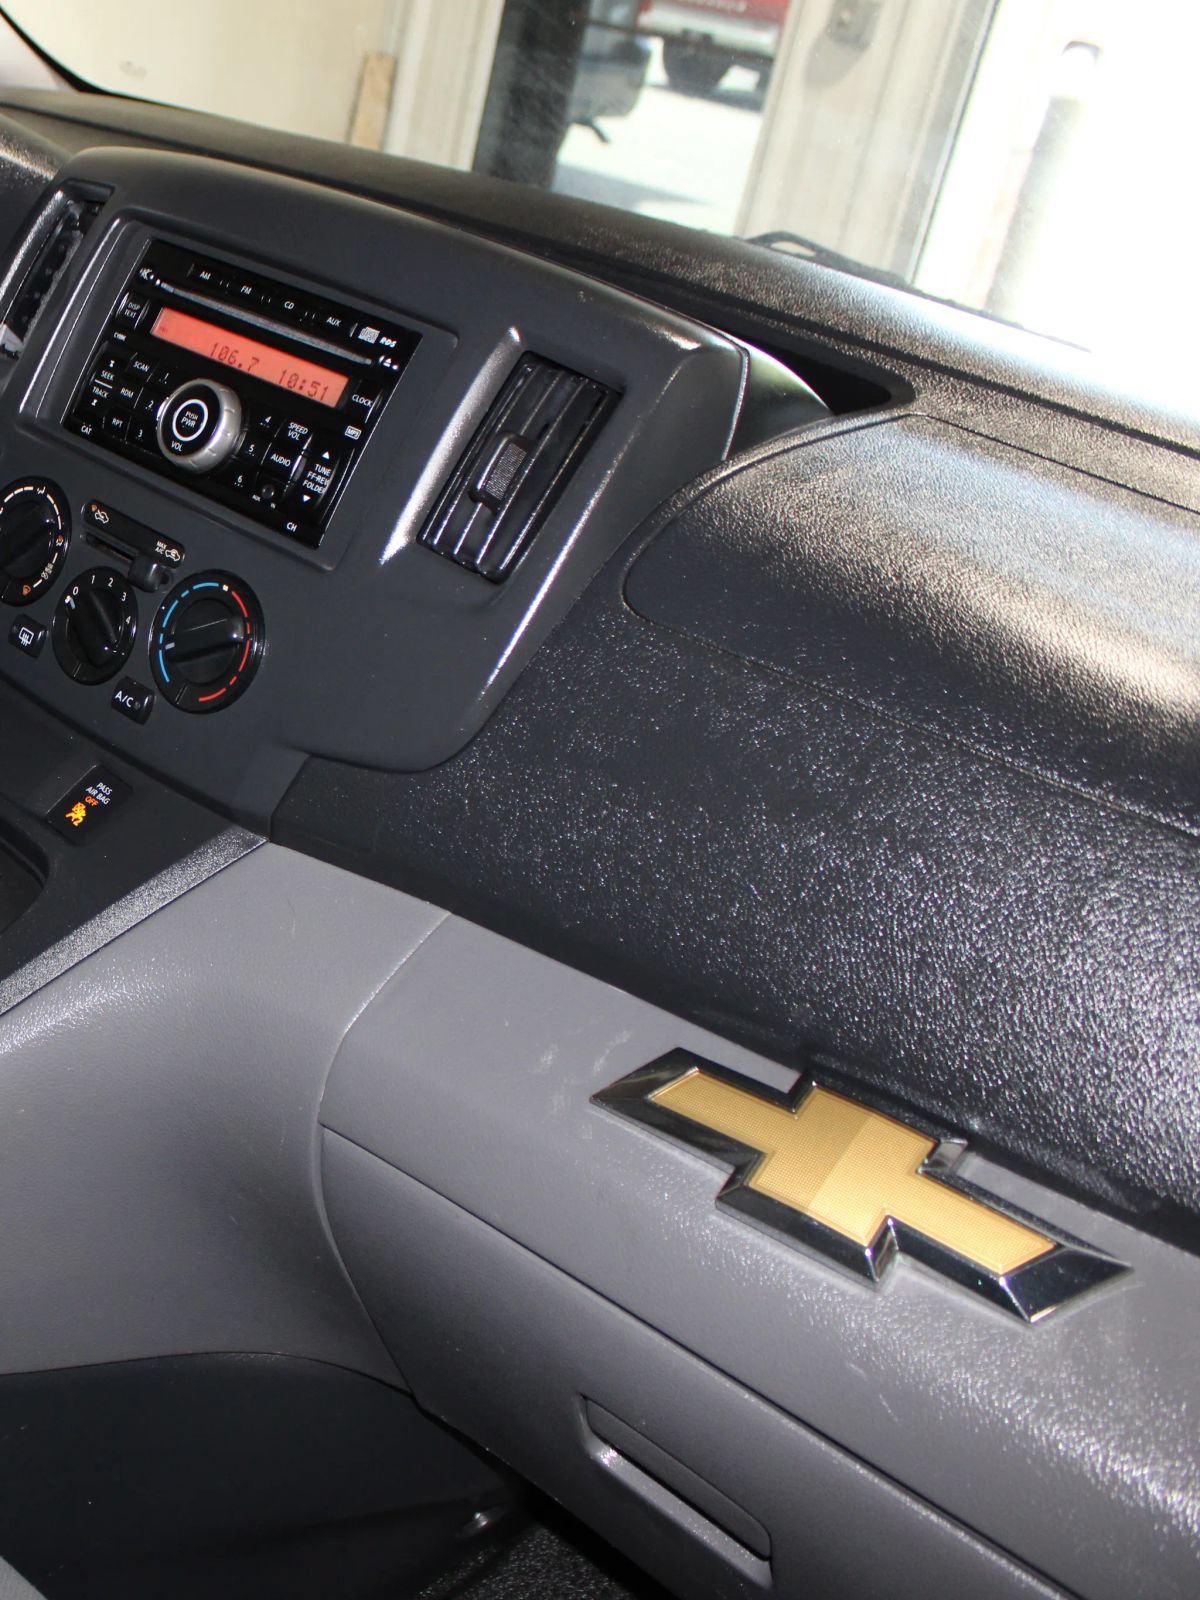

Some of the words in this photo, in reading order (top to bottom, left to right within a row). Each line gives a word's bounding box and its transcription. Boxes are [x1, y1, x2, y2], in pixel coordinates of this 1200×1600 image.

[200, 271, 211, 281] AM
[240, 285, 252, 296] FM
[284, 300, 295, 310] CD
[326, 316, 341, 328] AUX
[380, 336, 397, 348] RDS
[133, 360, 150, 373] SCAN
[210, 343, 259, 372] 106.7
[279, 370, 329, 401] 10:51
[100, 369, 116, 381] SEEK
[92, 386, 109, 399] TRACK
[120, 387, 135, 399] RDM
[351, 394, 373, 408] CLOCK
[111, 417, 124, 429] RPT
[181, 416, 196, 428] PWR
[80, 424, 93, 436] CAT
[288, 421, 309, 436] SPEED
[287, 430, 301, 442] VOL
[171, 440, 184, 452] VOL
[270, 453, 291, 468] AUDIO
[314, 463, 332, 477] TUNE
[286, 521, 298, 533] CH
[91, 574, 96, 584] 1
[108, 577, 114, 588] 2
[72, 586, 79, 596] 0
[121, 591, 127, 602] 3
[125, 615, 132, 625] 4
[114, 690, 134, 708] A/C
[96, 782, 112, 796] PASS
[85, 786, 98, 797] AIR
[96, 793, 111, 805] BAG
[85, 795, 99, 806] OFF
